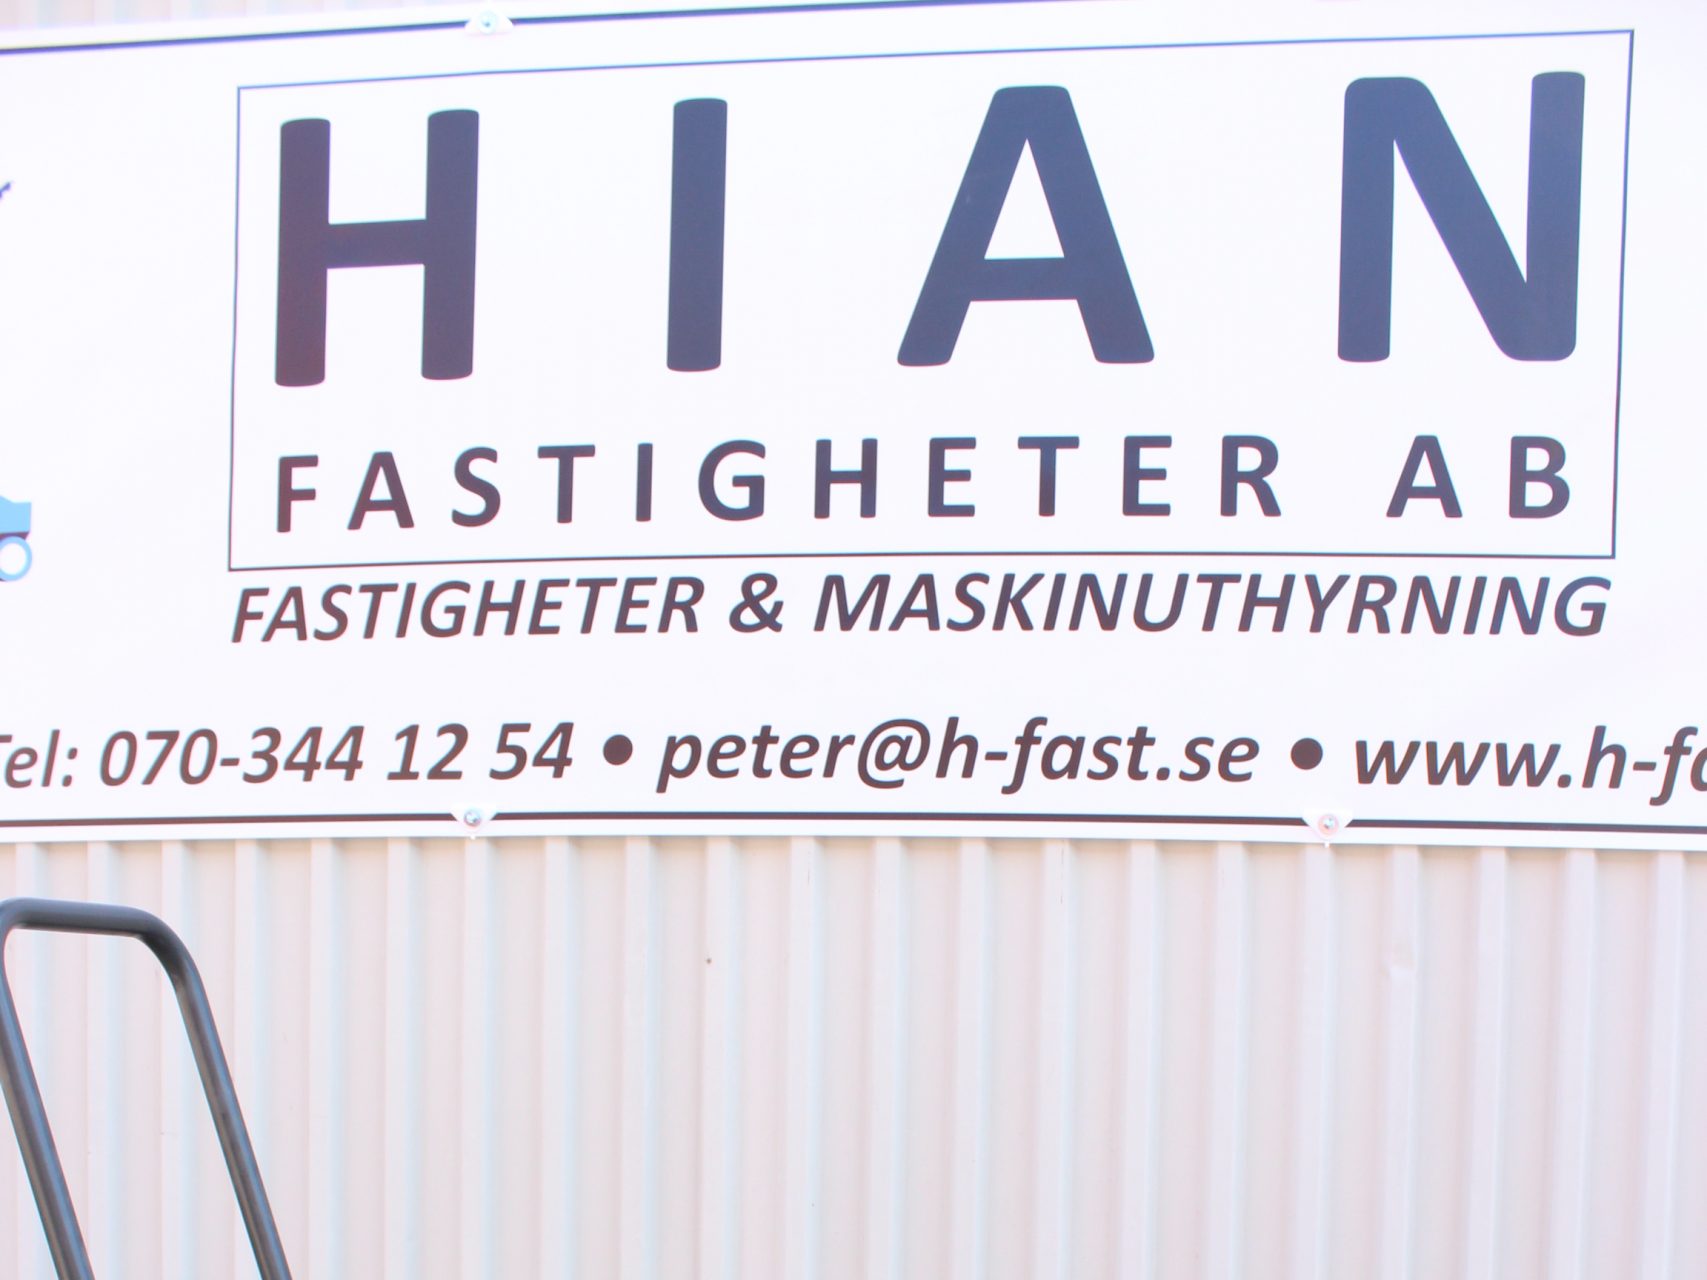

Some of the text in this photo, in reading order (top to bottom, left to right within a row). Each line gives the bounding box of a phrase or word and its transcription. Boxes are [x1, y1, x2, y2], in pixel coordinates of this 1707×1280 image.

[274, 72, 1586, 387] HIAN
[276, 435, 1570, 532] FASTIGHETER AB
[232, 573, 1611, 643] FASTIGHETER & MASKINUTHYRNING
[100, 725, 364, 786] 070-344
[388, 724, 468, 780] 12
[490, 722, 573, 780] 54
[656, 717, 1259, 794] peter@h-fast.se
